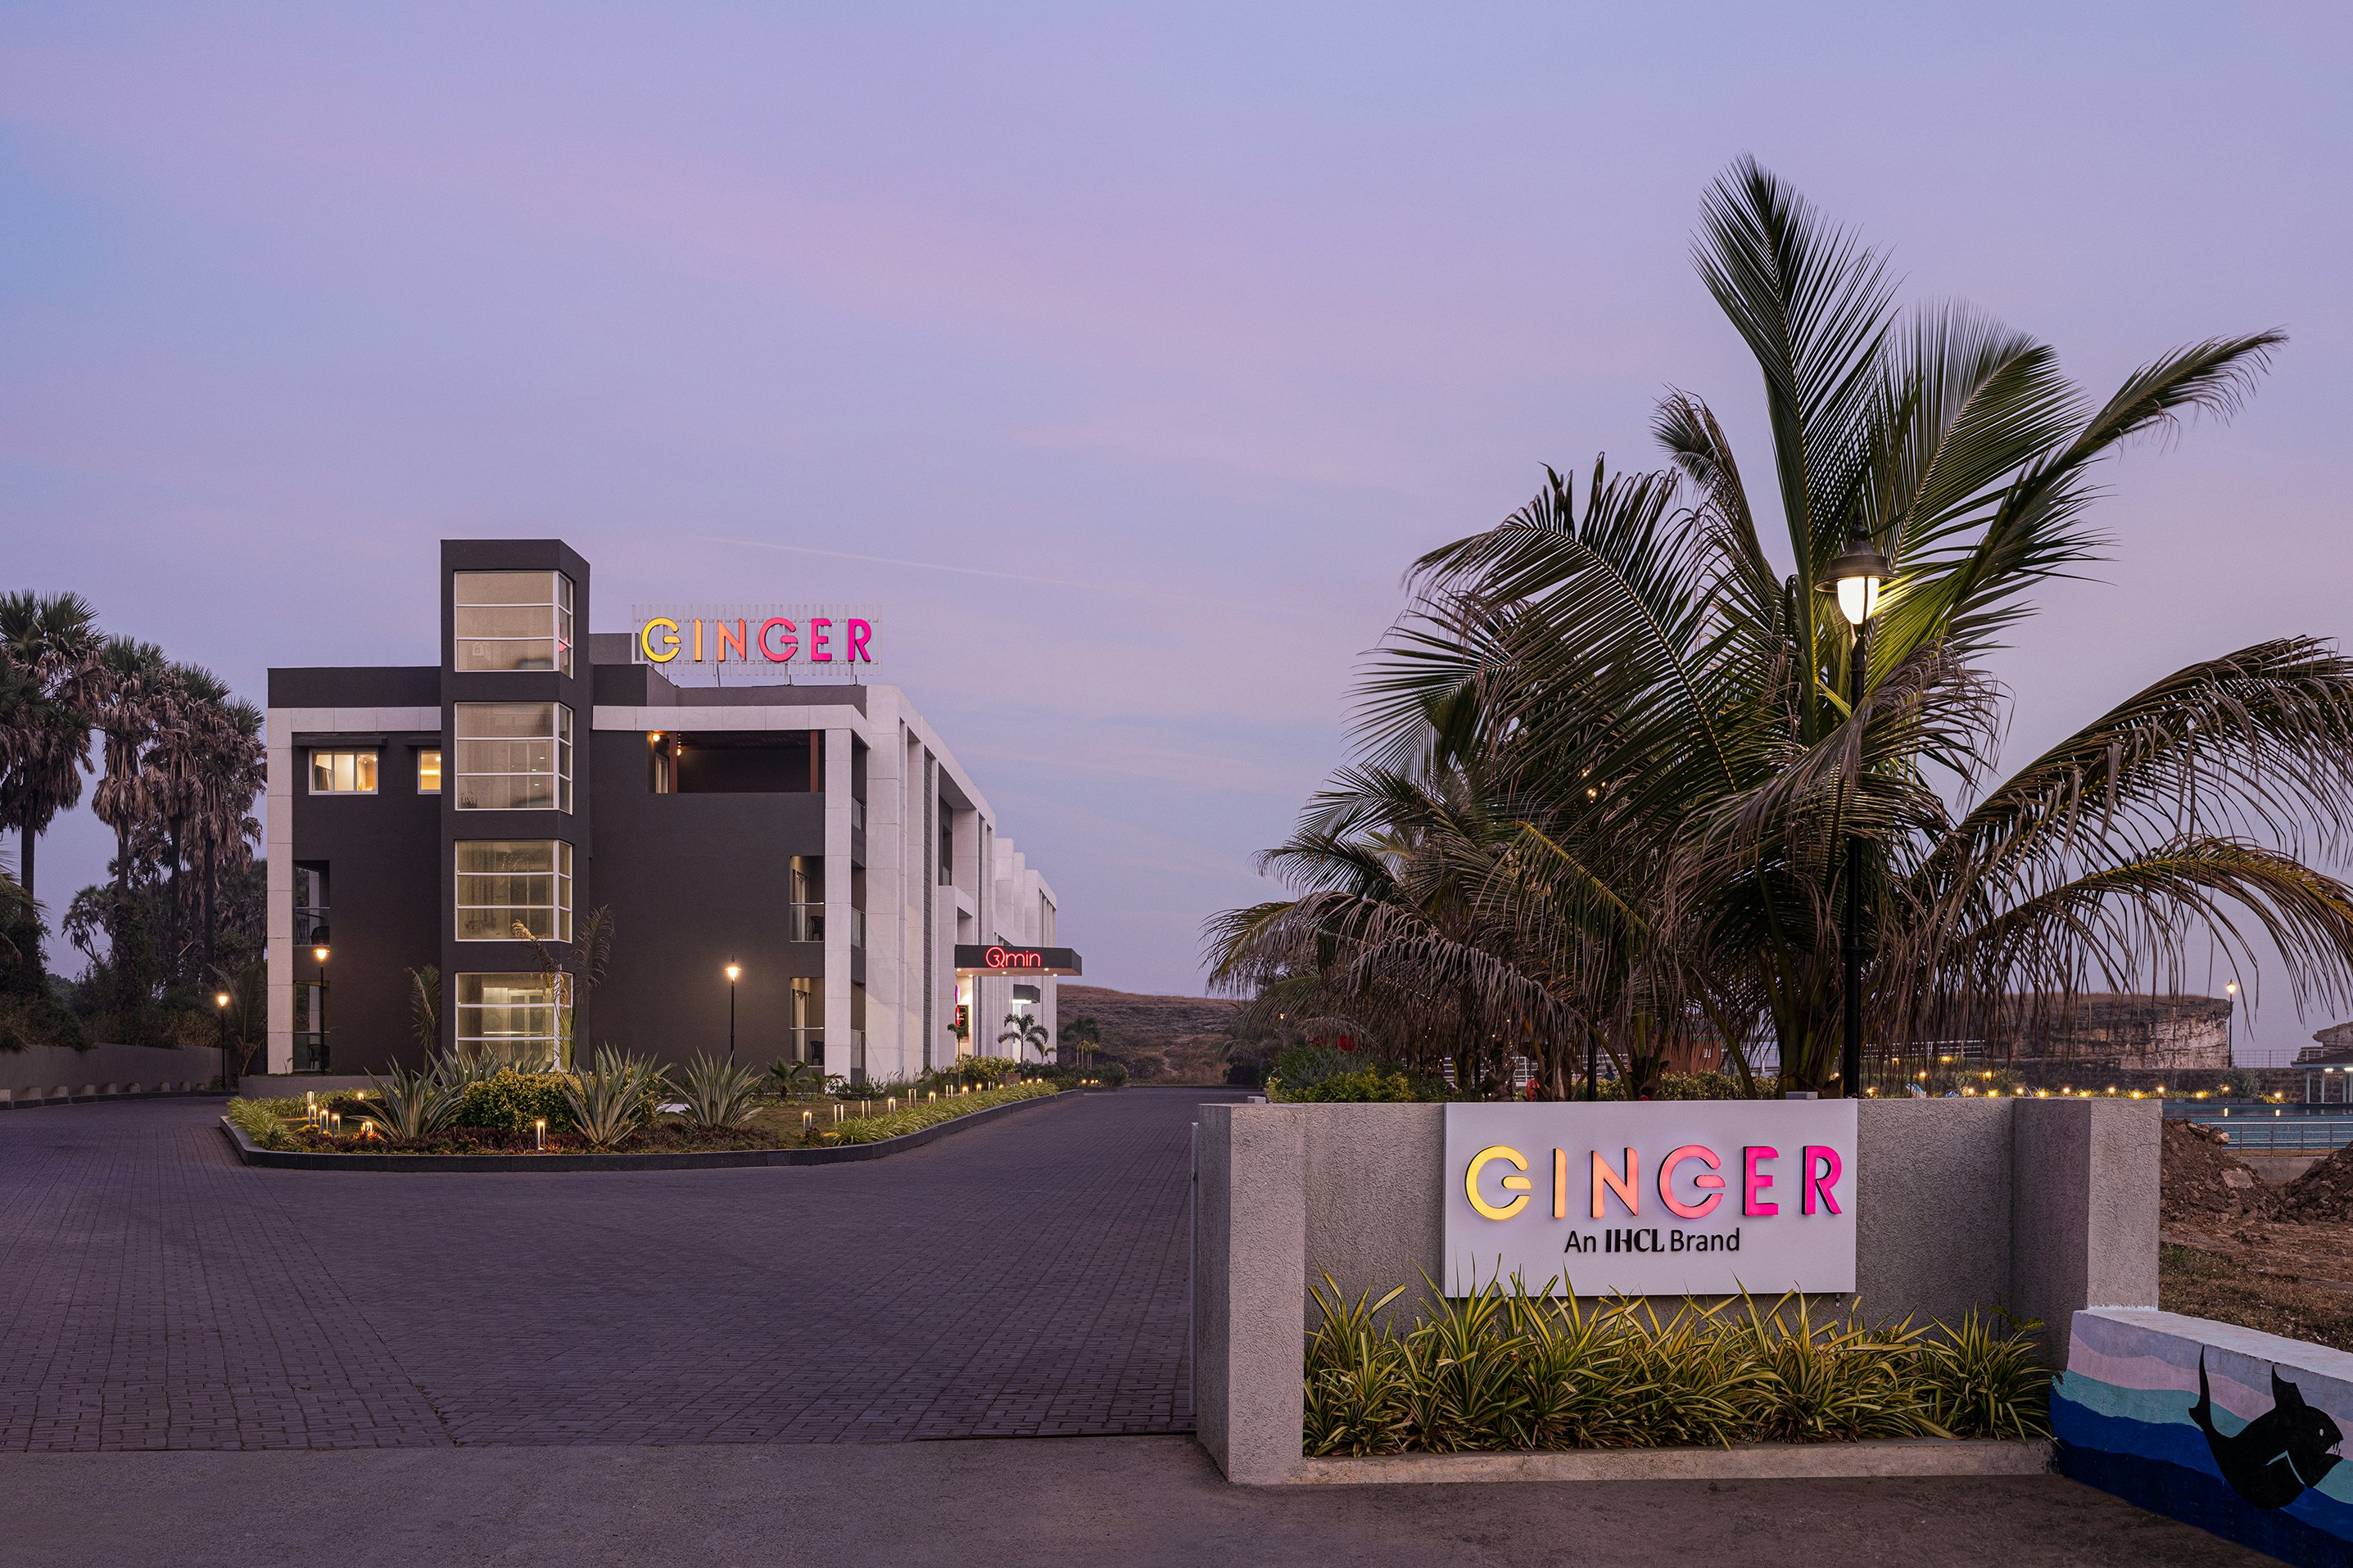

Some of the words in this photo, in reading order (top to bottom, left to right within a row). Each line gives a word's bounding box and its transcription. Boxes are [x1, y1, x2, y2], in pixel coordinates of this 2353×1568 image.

[641, 617, 871, 662] GINGER
[985, 947, 1041, 968] Qmin
[1465, 1145, 1842, 1220] GINGER
[1564, 1230, 1596, 1253] An
[1605, 1229, 1664, 1252] IHCL
[1671, 1227, 1740, 1252] Brand
